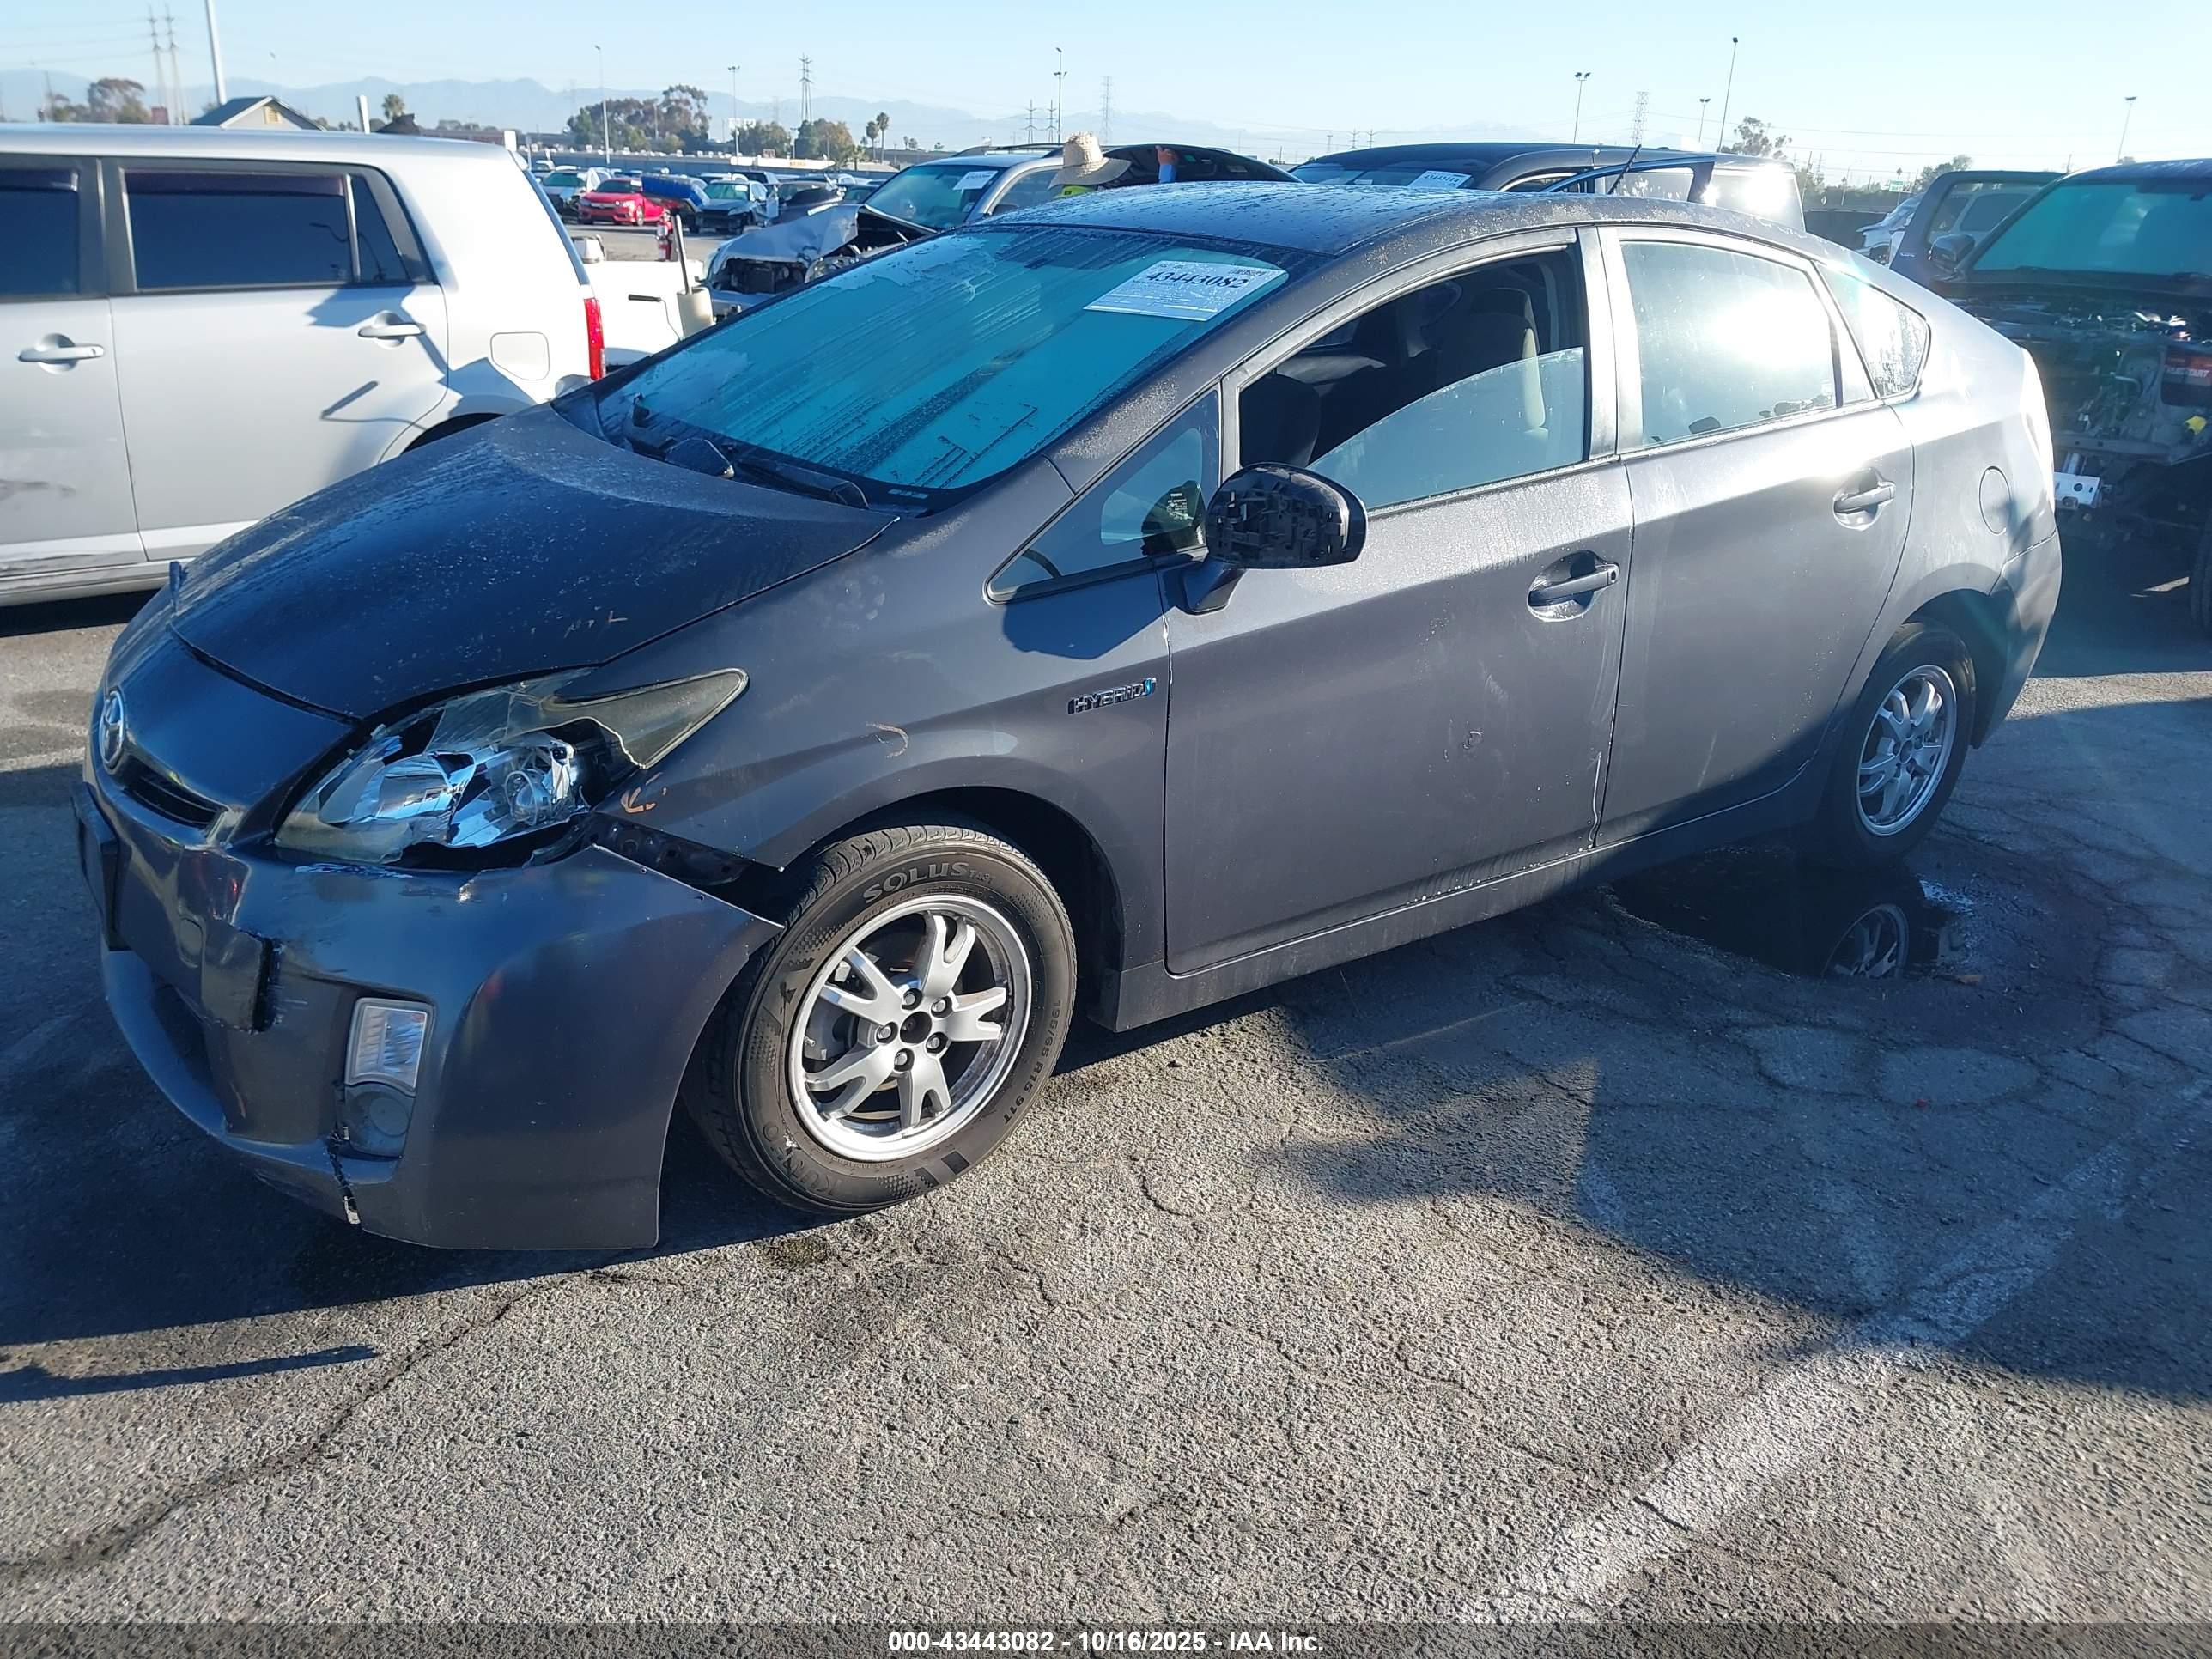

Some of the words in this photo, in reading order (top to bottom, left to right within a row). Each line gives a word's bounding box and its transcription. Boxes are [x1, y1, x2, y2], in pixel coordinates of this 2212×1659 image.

[1146, 271, 1249, 289] 43443082
[1067, 680, 1151, 714] HYBRID
[862, 862, 969, 904] SOLUS
[1041, 1000, 1061, 1058] 195/65
[1024, 1061, 1044, 1093] R15
[1003, 1095, 1024, 1125] 91T
